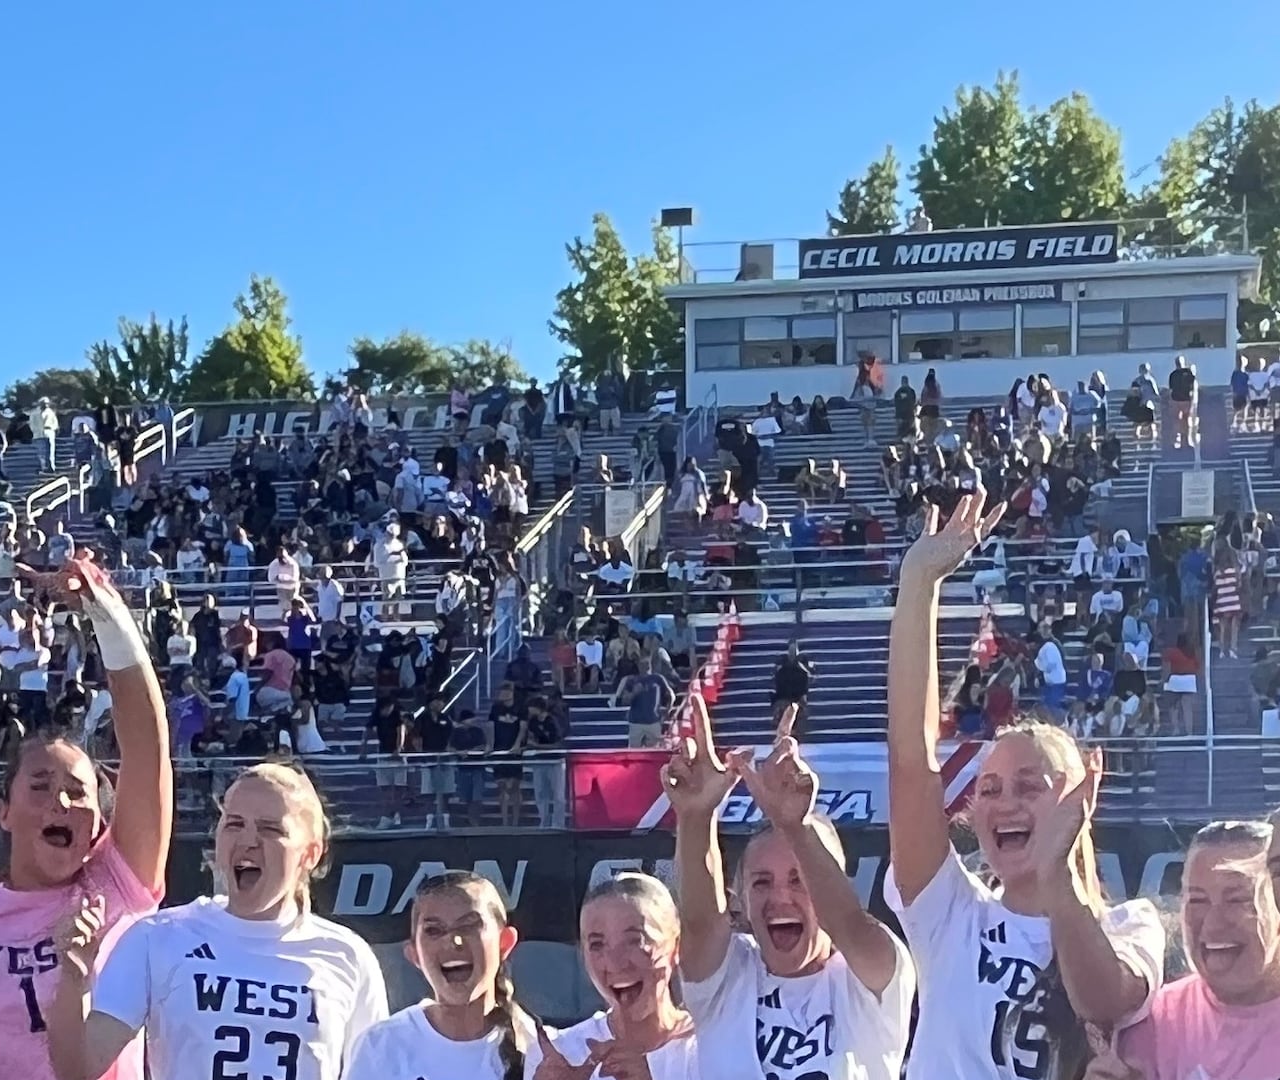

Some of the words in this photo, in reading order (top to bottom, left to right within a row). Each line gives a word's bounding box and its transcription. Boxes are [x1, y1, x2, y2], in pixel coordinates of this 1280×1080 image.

[802, 246, 880, 270] CECIL
[892, 239, 1017, 266] MORRIS
[1026, 234, 1115, 259] FIELD
[332, 859, 529, 915] DAN
[19, 976, 47, 1033] 1
[193, 973, 320, 1025] WEST
[990, 1000, 1050, 1080] 15
